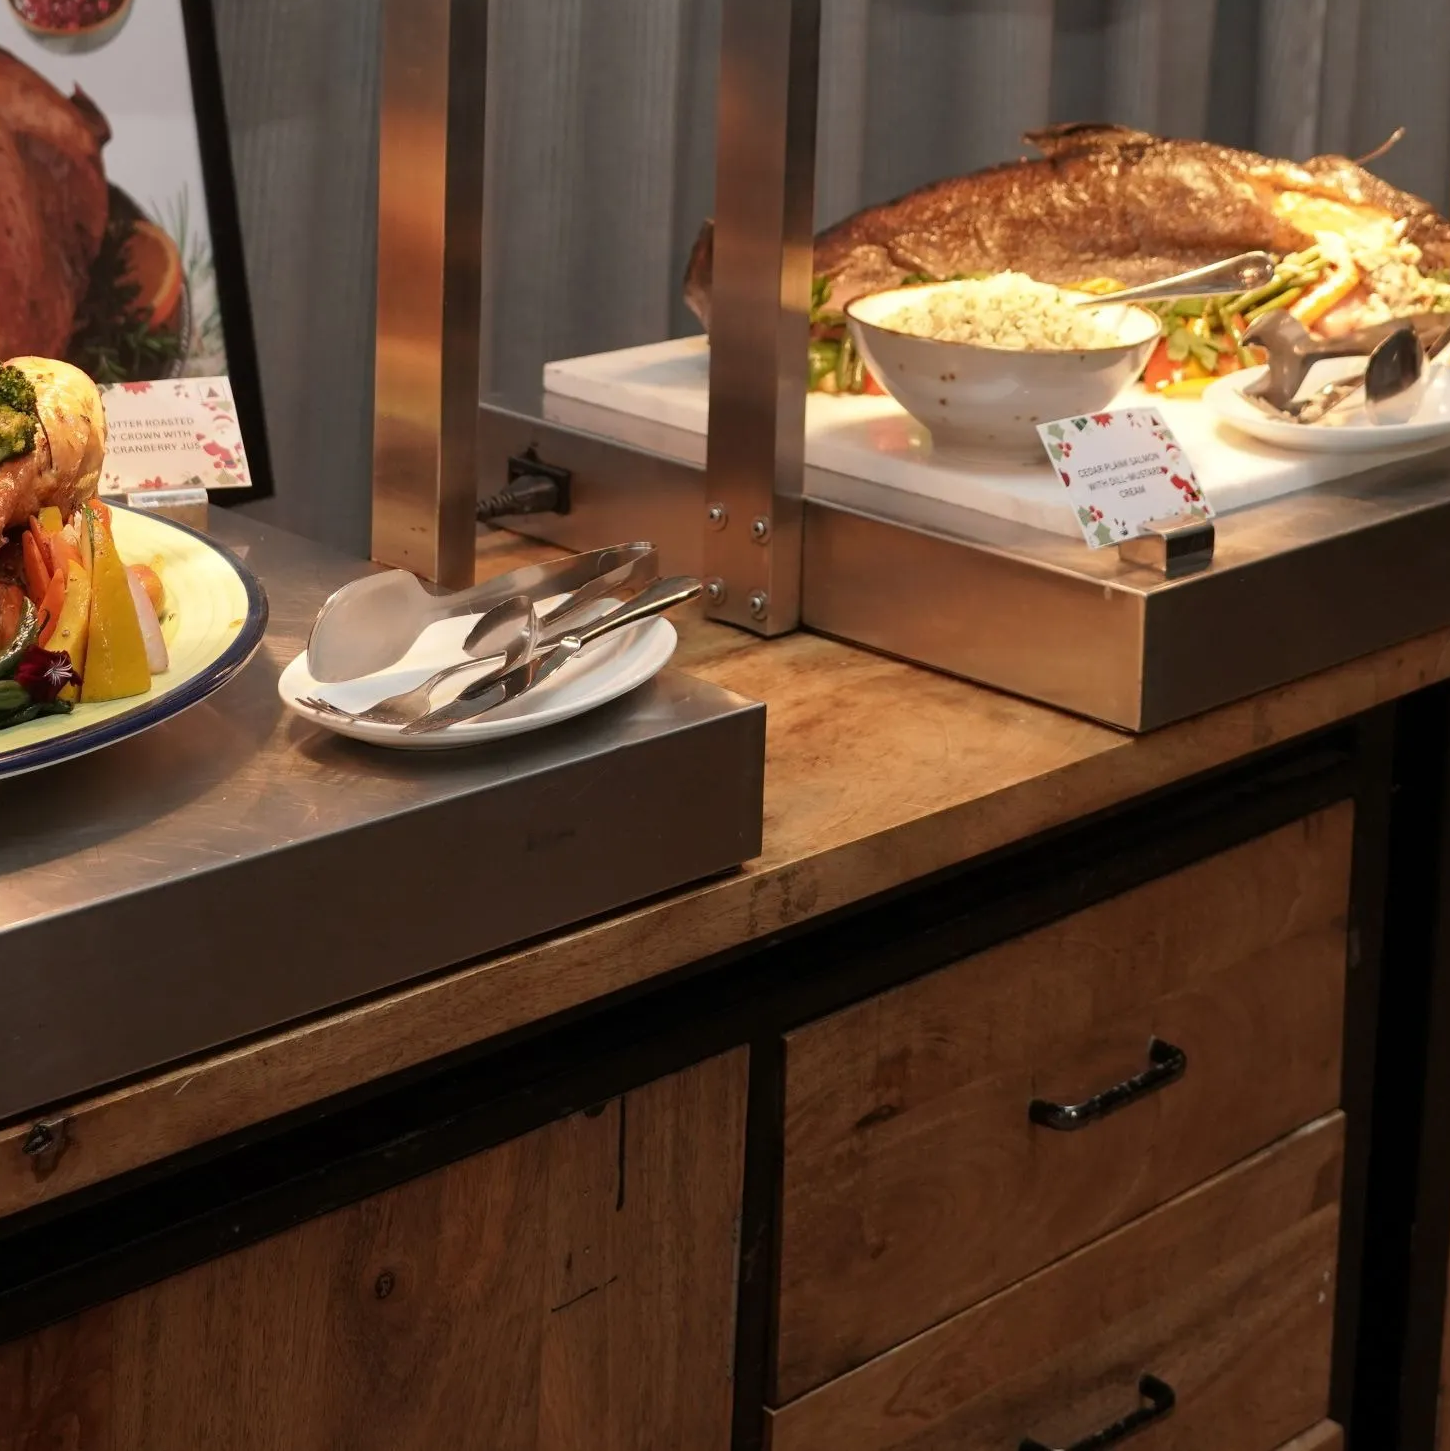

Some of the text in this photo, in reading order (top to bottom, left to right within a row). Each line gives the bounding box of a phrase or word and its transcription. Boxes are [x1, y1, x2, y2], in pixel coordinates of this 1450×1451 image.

[145, 417, 195, 428] ROASTED
[120, 431, 161, 441] CROWN
[163, 429, 192, 439] WITH
[113, 443, 178, 455] CRANBERRY
[1078, 464, 1104, 478] CEDAR
[1128, 452, 1160, 466] SALMON
[1118, 485, 1146, 498] CREAM
